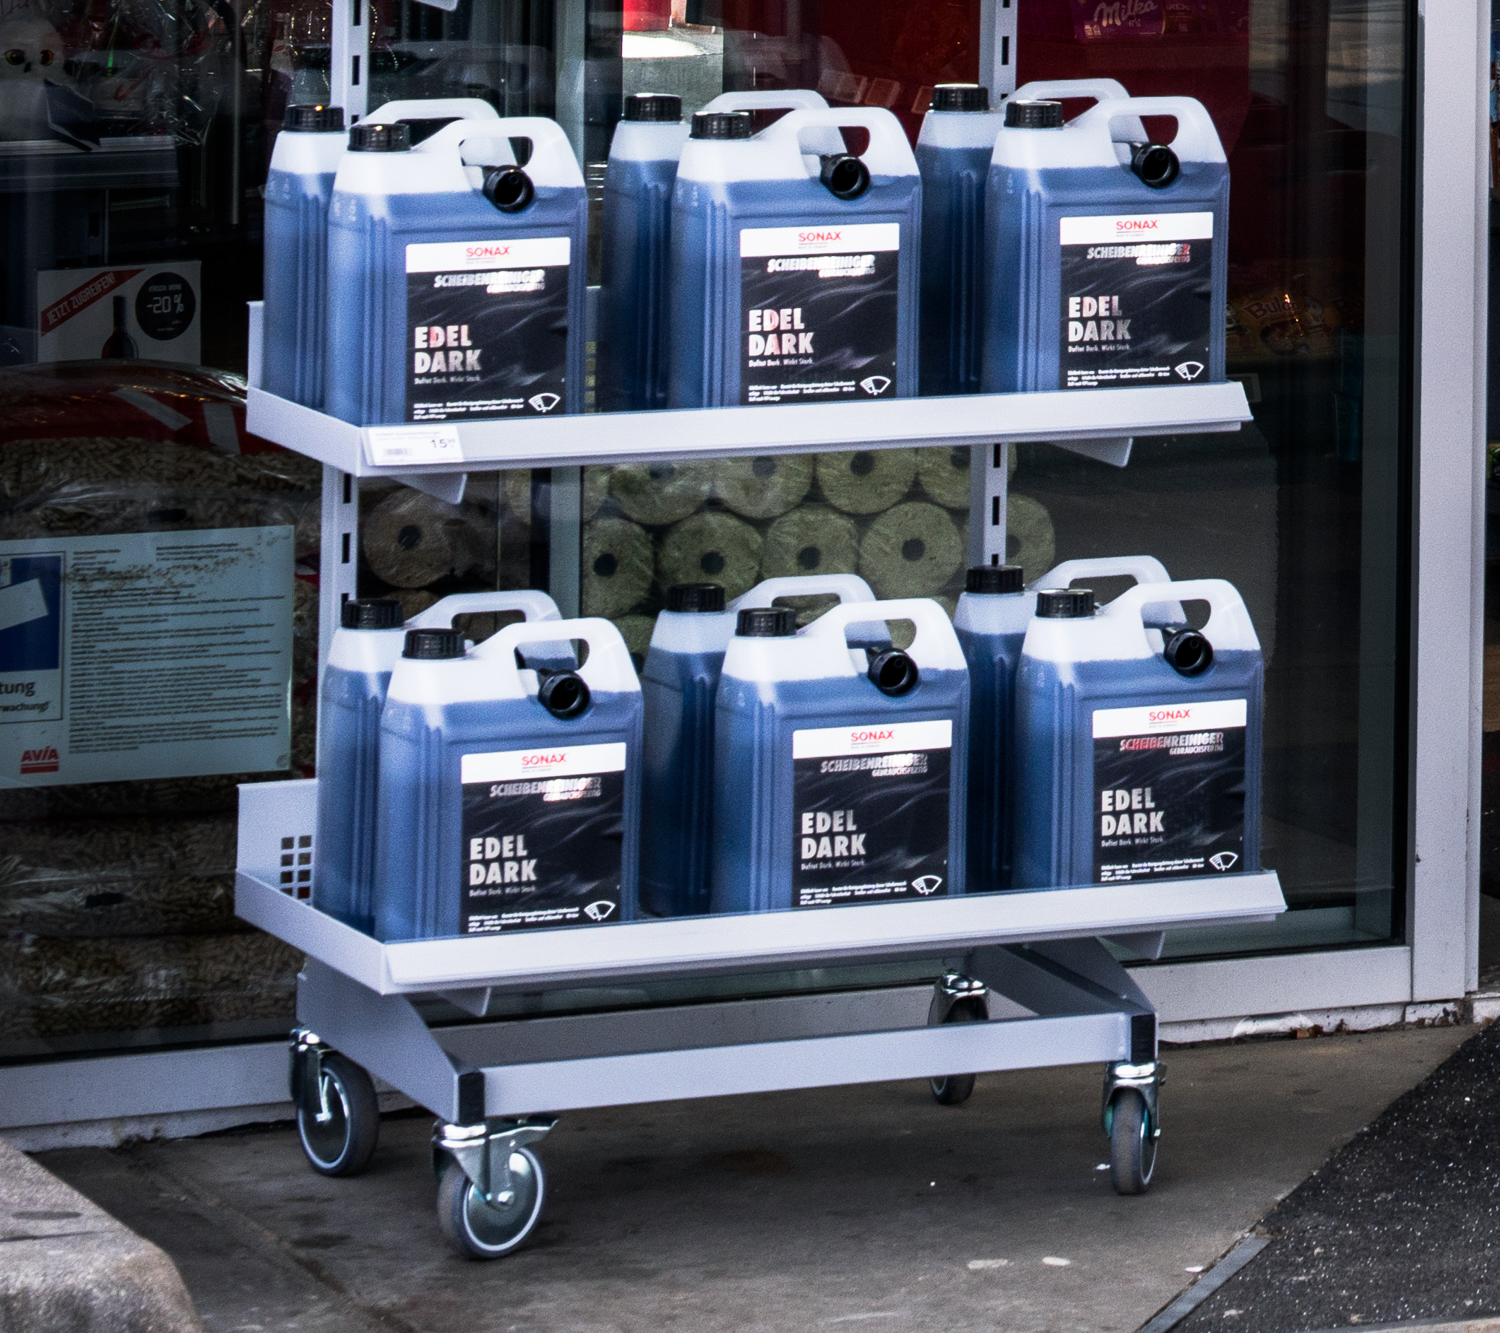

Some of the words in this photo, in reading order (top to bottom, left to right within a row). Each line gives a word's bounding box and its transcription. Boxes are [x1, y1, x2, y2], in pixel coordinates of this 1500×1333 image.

[798, 231, 841, 242] SONAX
[1068, 296, 1123, 319] EDEL
[748, 308, 804, 332] EDEL
[1068, 319, 1131, 343] DARK
[748, 332, 814, 357] DARK
[20, 745, 59, 762] AVIA
[1101, 787, 1155, 812] EDEL
[1101, 811, 1165, 837] DARK
